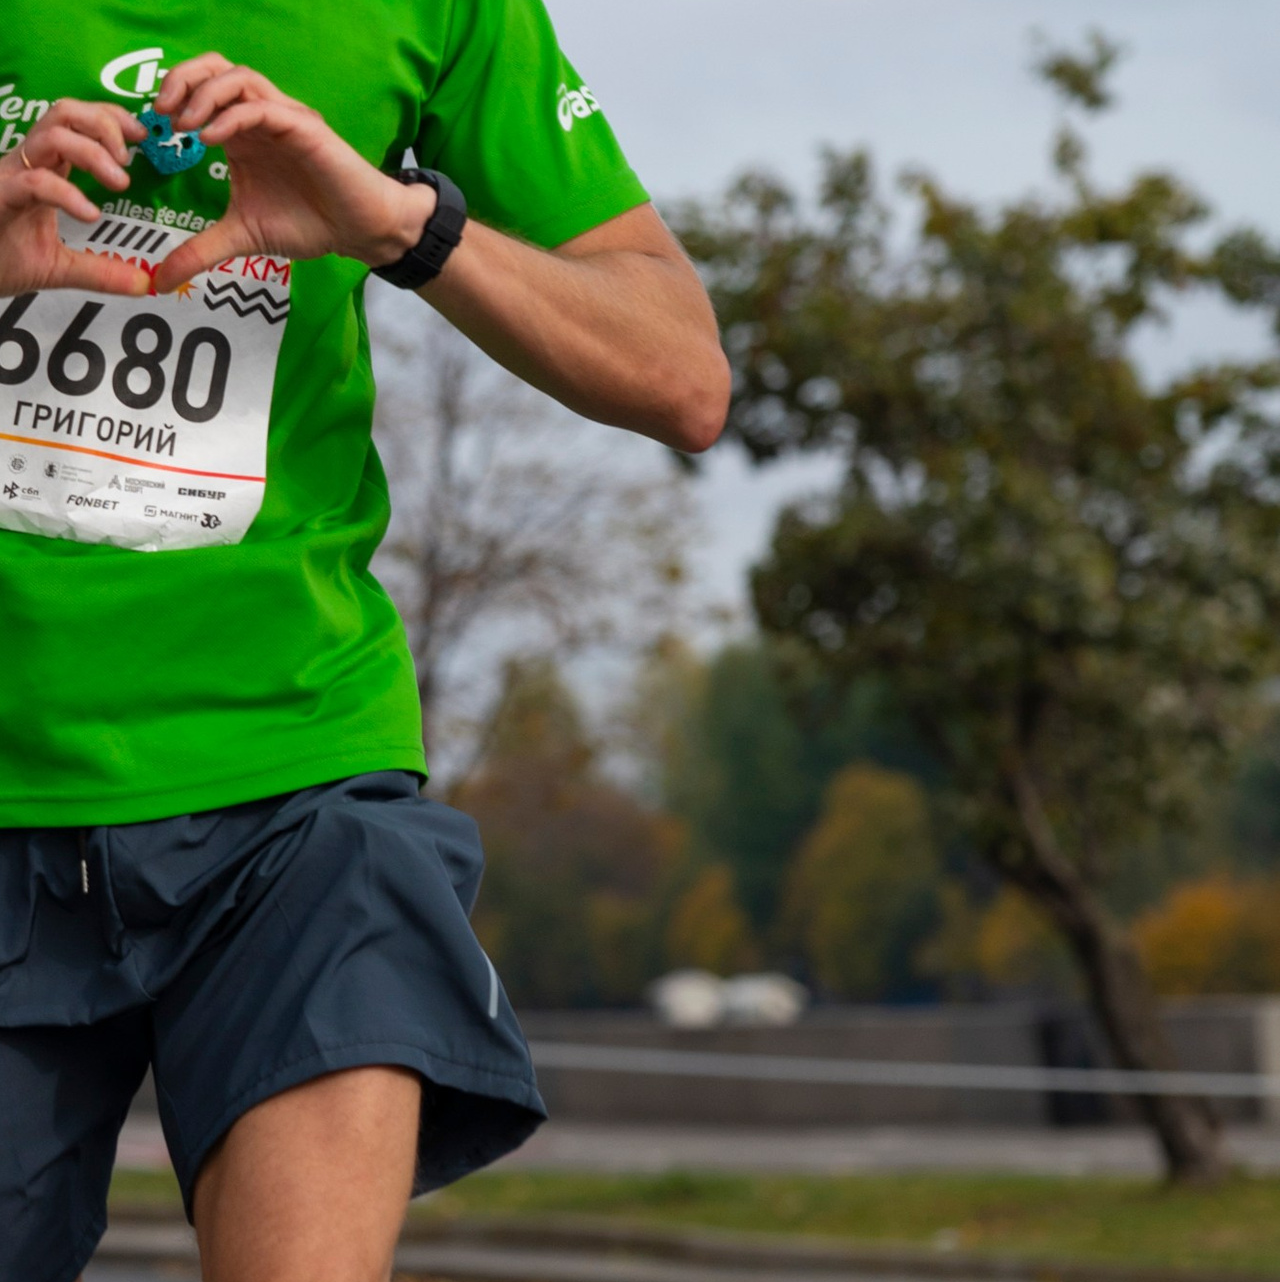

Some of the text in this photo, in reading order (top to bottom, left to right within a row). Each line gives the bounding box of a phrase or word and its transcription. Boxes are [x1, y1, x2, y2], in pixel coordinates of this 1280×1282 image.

[102, 199, 154, 221] alles
[241, 256, 290, 287] KM
[13, 401, 177, 457] ГРИГОРИЙ
[66, 494, 120, 511] FONBET
[178, 487, 227, 500] СИБУР
[160, 508, 199, 523] МАГНИТ
